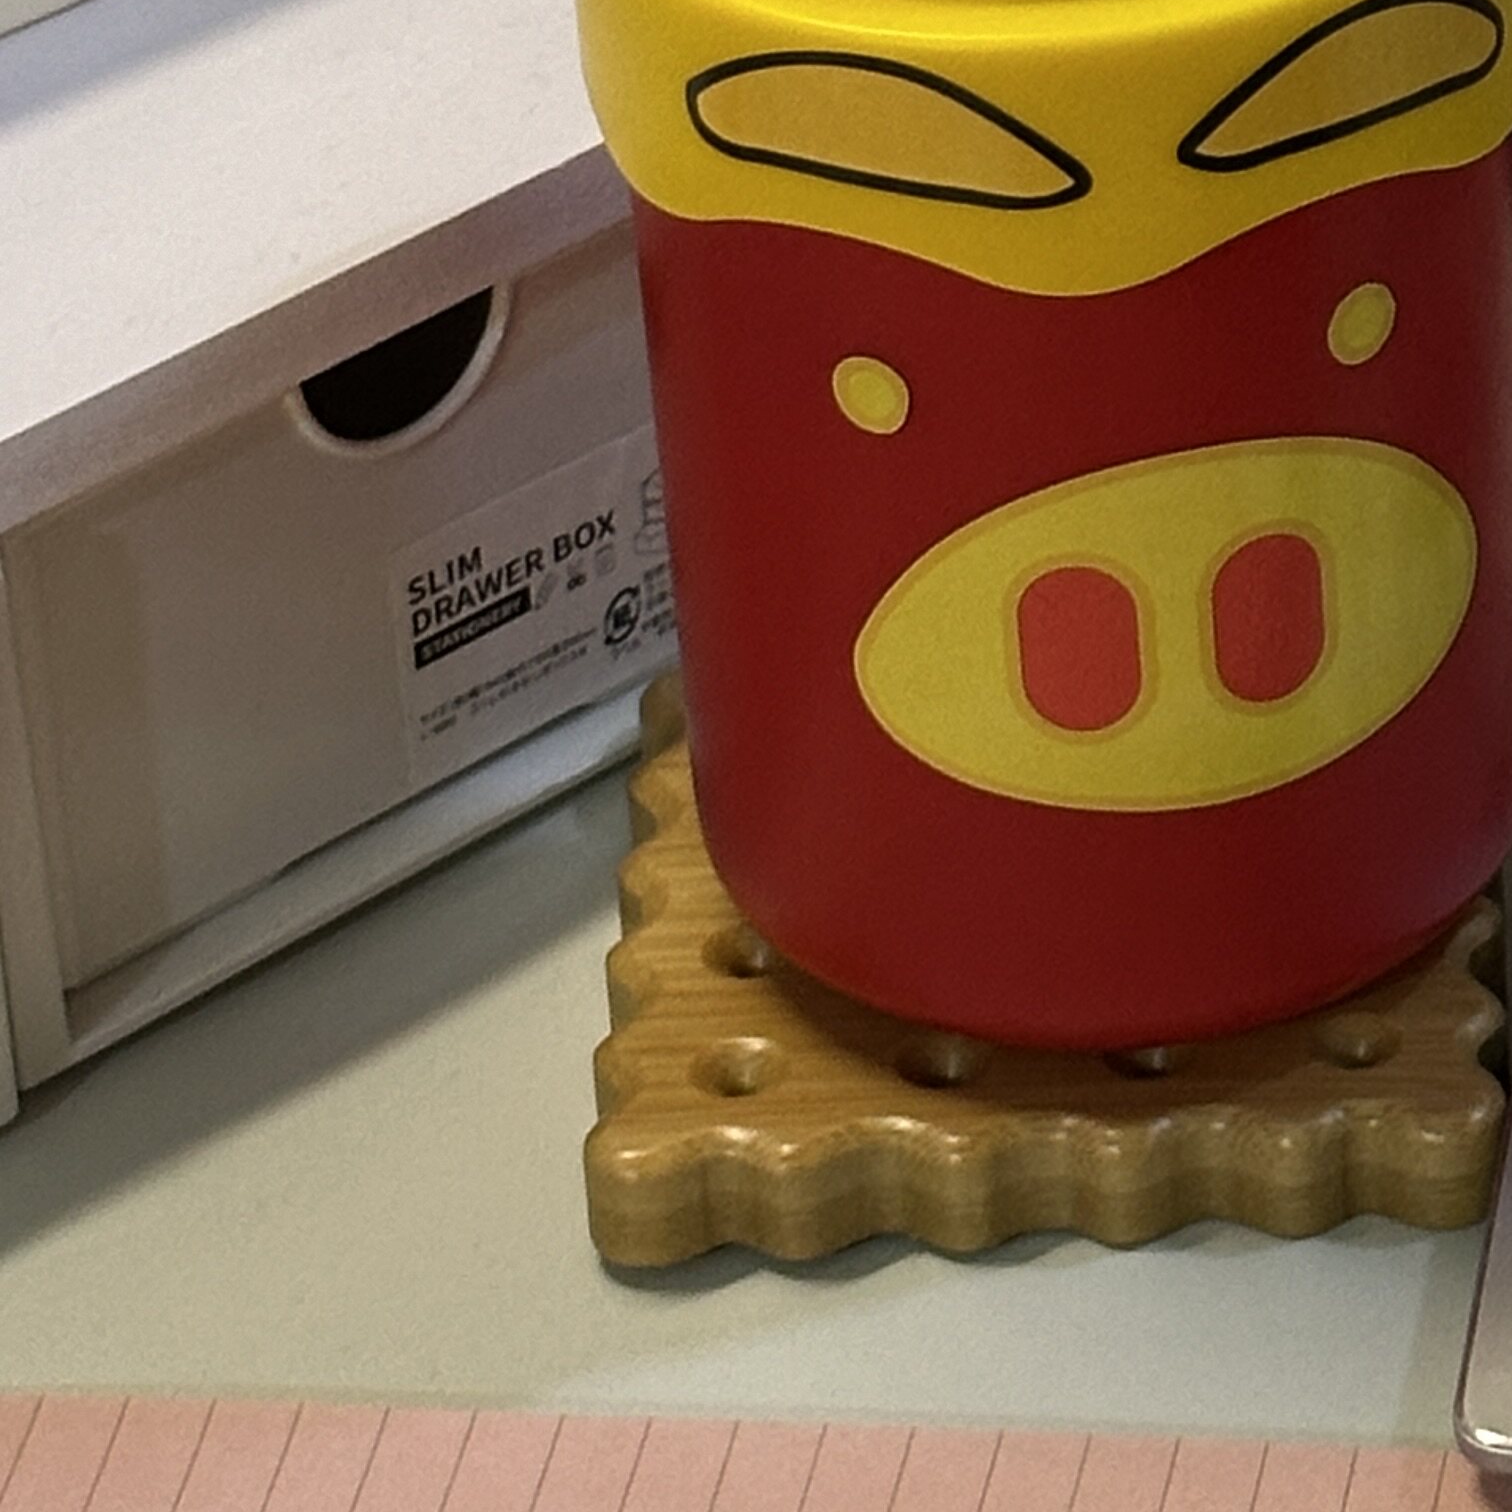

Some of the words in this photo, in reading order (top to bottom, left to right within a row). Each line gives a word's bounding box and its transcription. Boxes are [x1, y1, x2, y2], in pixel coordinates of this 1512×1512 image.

[408, 546, 483, 606] SLIM
[412, 548, 546, 637] DRAWER
[552, 509, 617, 563] BOX
